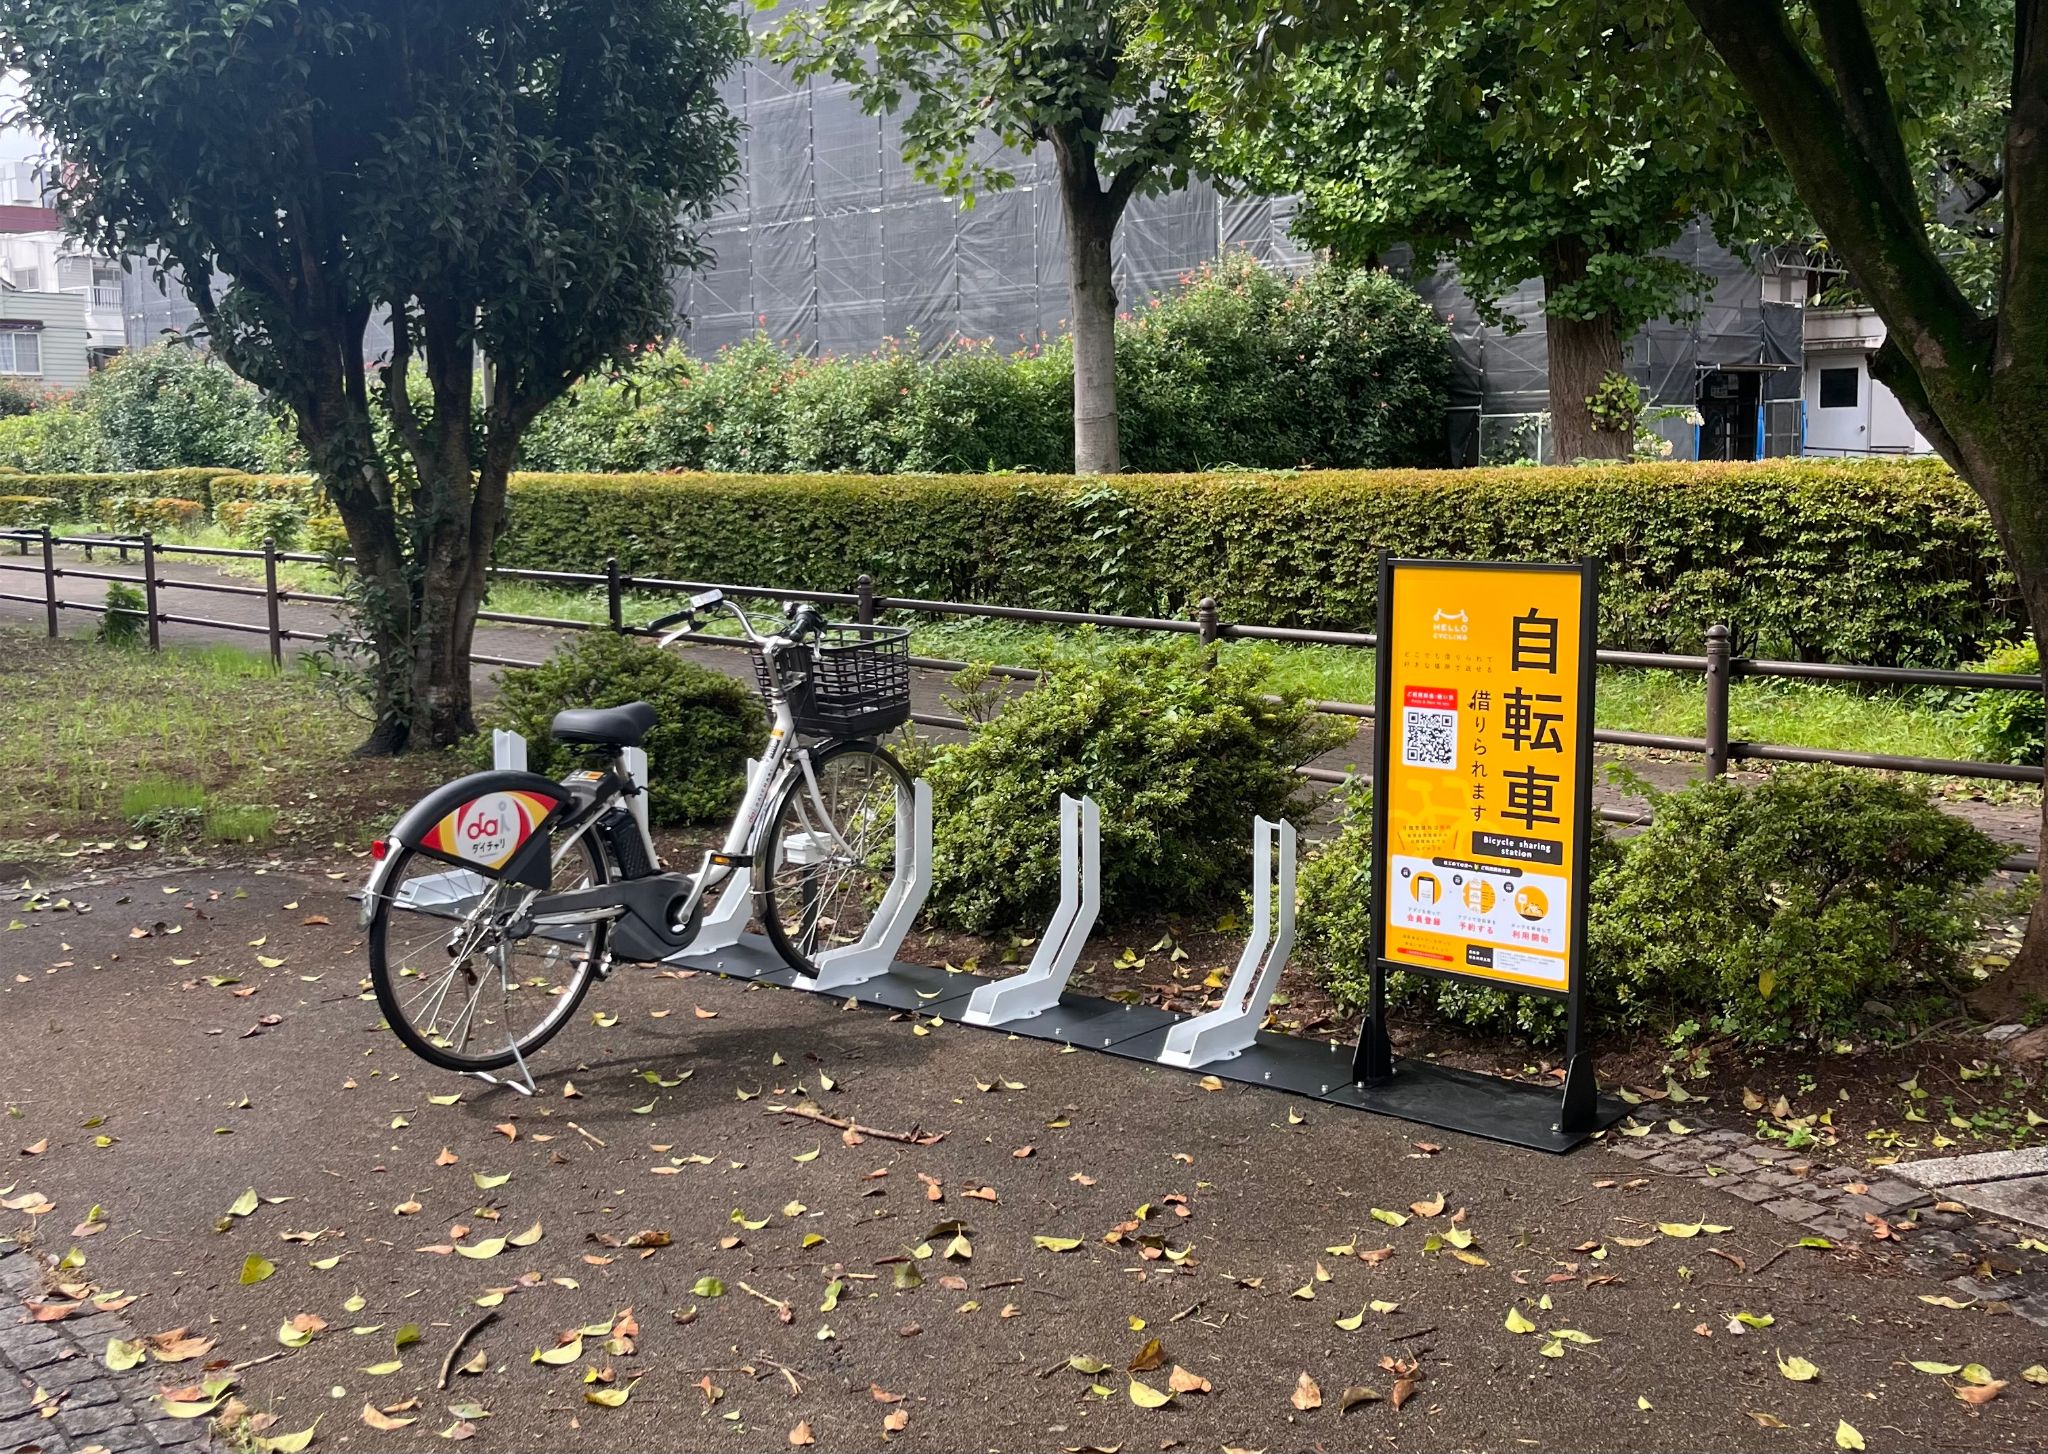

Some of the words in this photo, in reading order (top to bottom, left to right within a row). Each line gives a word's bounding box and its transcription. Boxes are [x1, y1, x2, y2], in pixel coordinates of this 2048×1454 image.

[1433, 623, 1468, 632] HELLO
[1433, 633, 1468, 641] CYCLING
[1501, 608, 1563, 830] 自転車
[1470, 689, 1492, 822] 借りられます
[472, 838, 506, 854] ダイチャリ
[1483, 835, 1515, 847] Bicycle
[1519, 840, 1551, 854] sharing
[1501, 848, 1533, 858] station
[1407, 913, 1441, 926] 会員登録
[1459, 921, 1494, 935] 予約する
[1511, 930, 1549, 944] 利用開始
